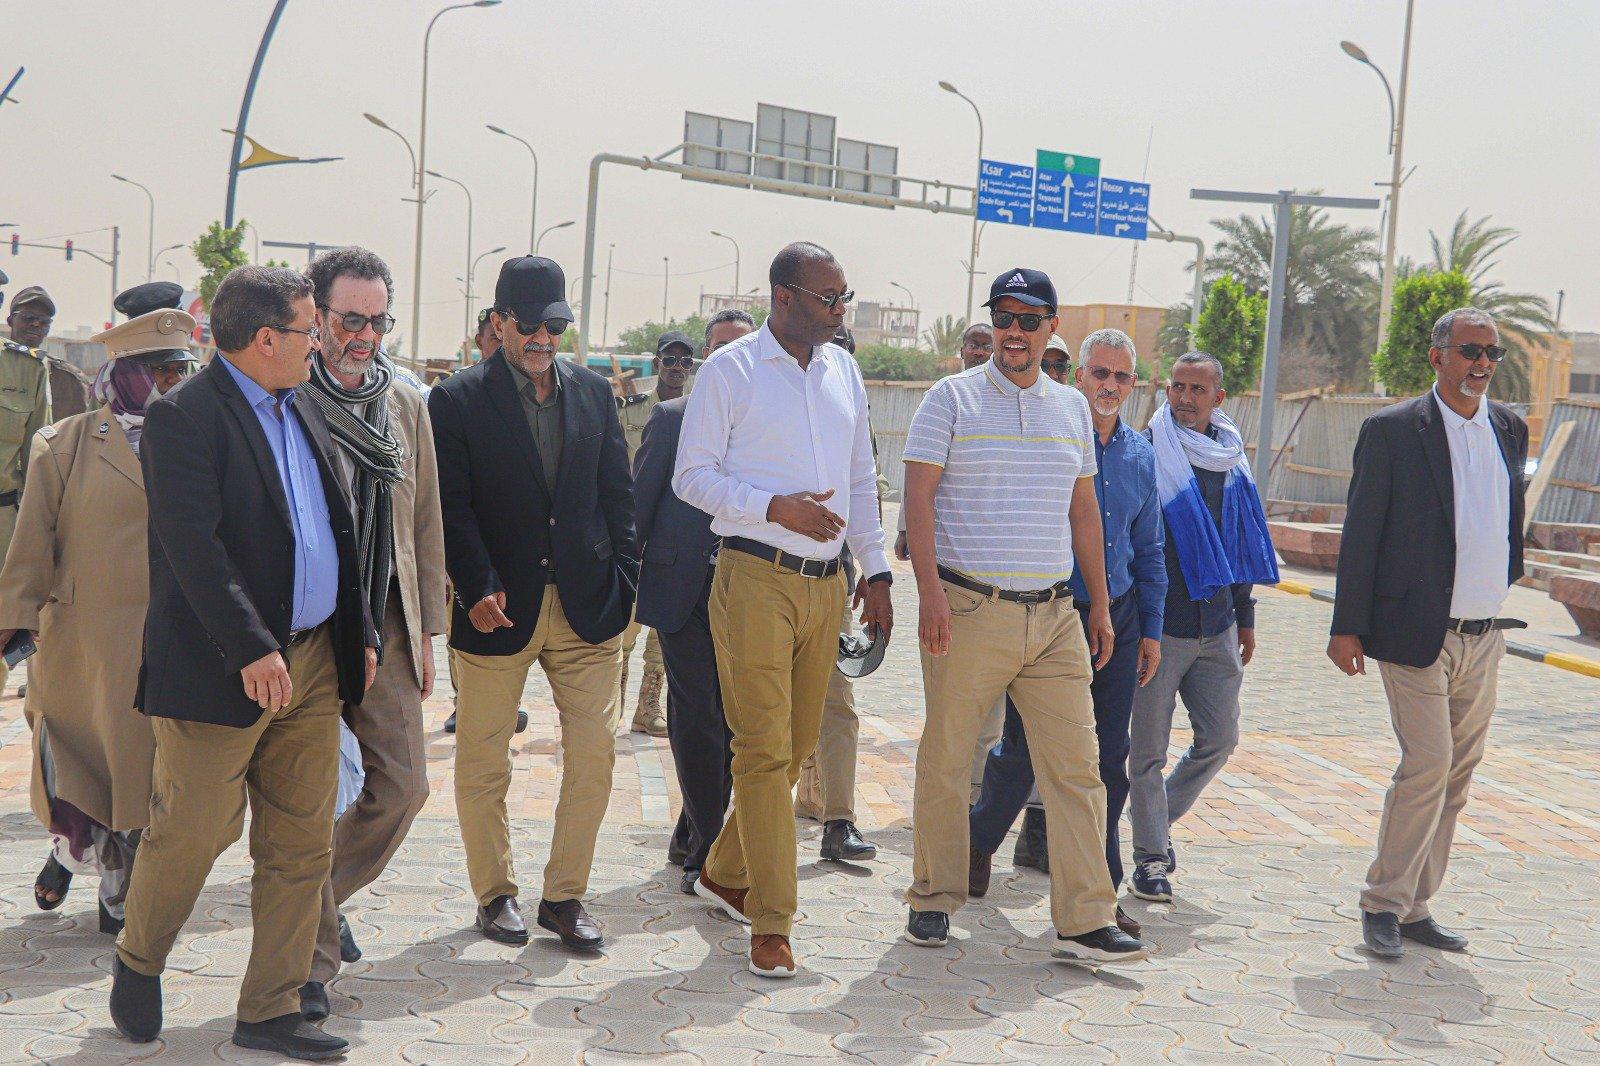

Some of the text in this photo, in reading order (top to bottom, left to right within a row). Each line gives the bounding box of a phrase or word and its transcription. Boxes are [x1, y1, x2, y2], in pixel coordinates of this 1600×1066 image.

[983, 163, 1003, 176] Ksar
[1039, 173, 1052, 181] Atar
[980, 179, 988, 191] H
[1039, 183, 1060, 193] Akjoujt
[1102, 182, 1123, 193] Rosso
[980, 196, 994, 205] Stade
[1037, 204, 1048, 212] Dar
[1100, 211, 1147, 223] Carrefour Madrid
